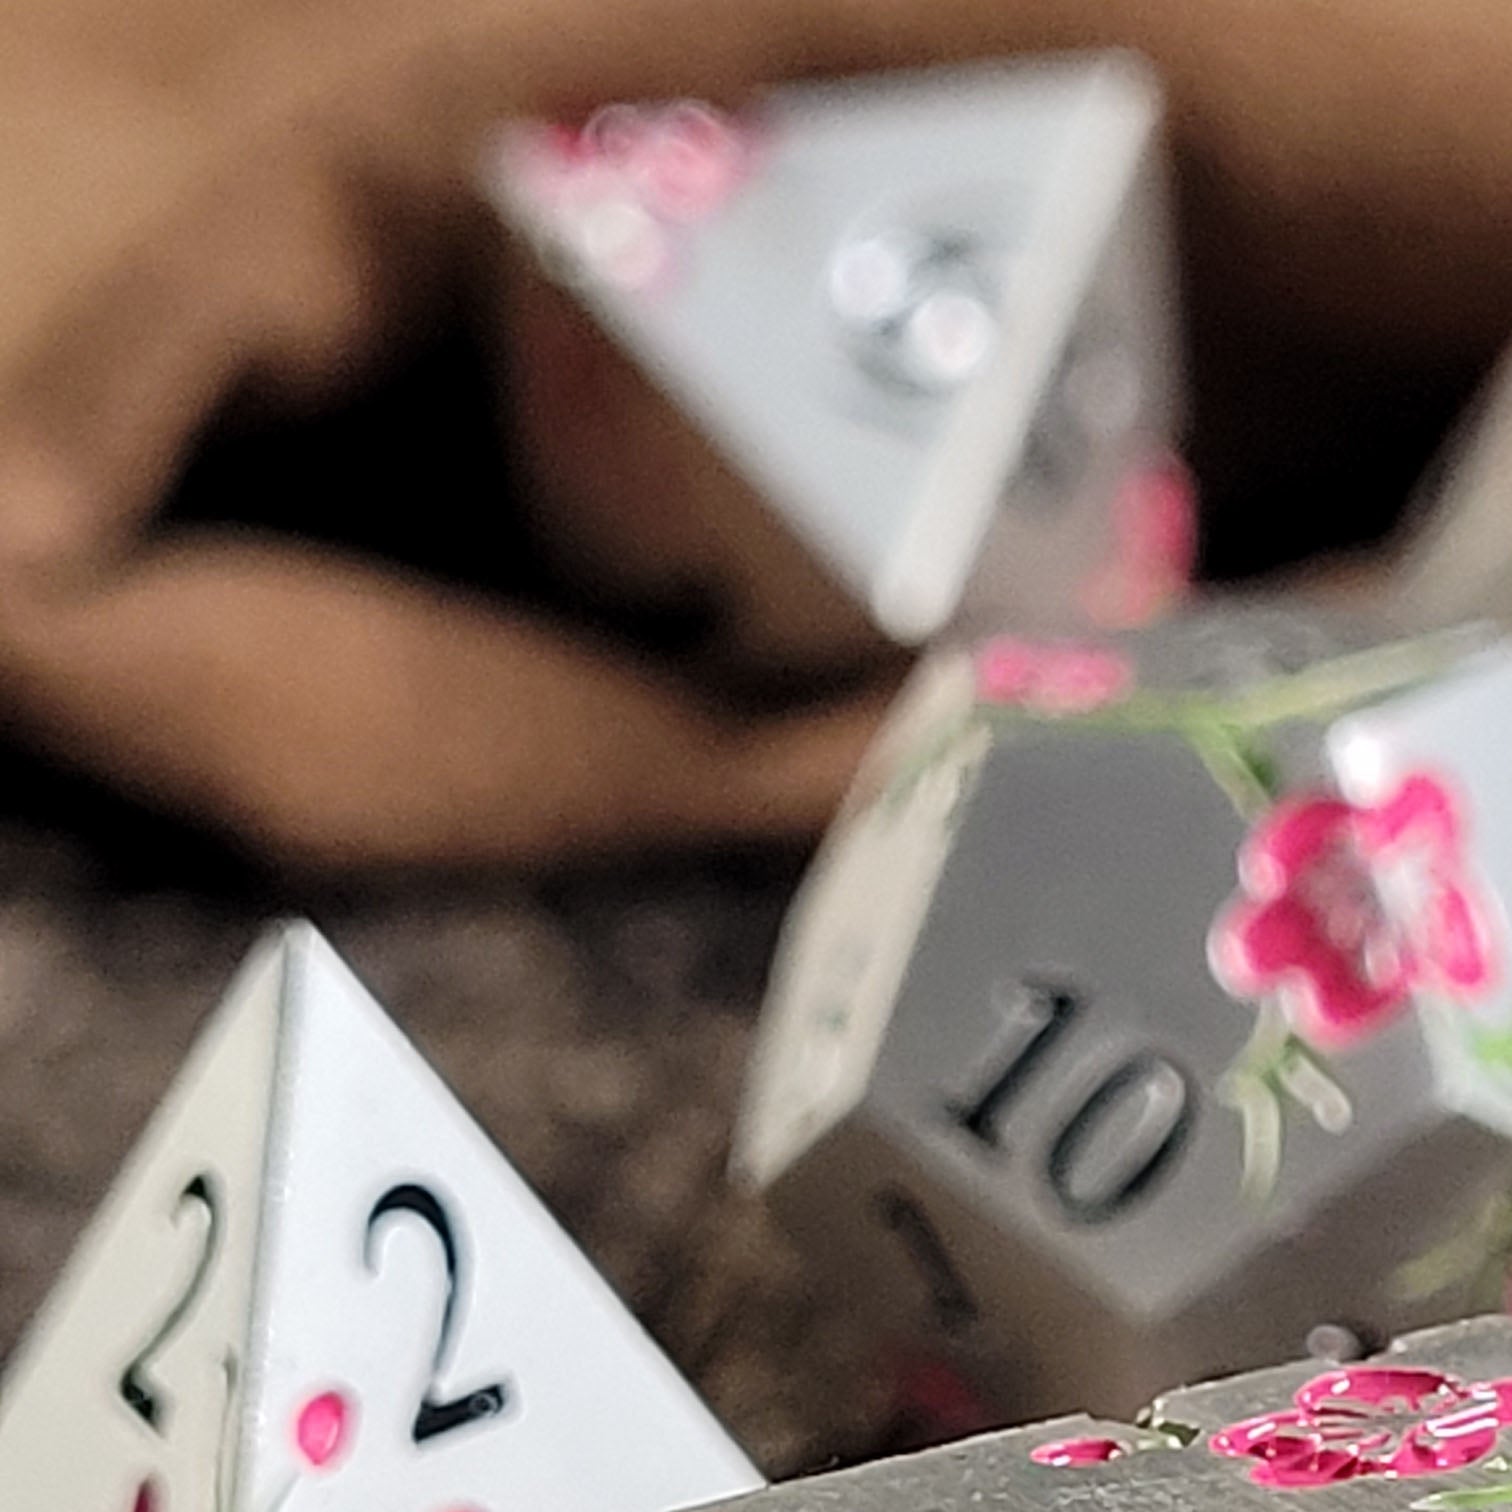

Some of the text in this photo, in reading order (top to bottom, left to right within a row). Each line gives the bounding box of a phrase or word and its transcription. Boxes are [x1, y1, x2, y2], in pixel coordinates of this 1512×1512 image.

[945, 985, 1190, 1225] 10
[118, 1172, 217, 1436] 2
[362, 1183, 518, 1443] 2
